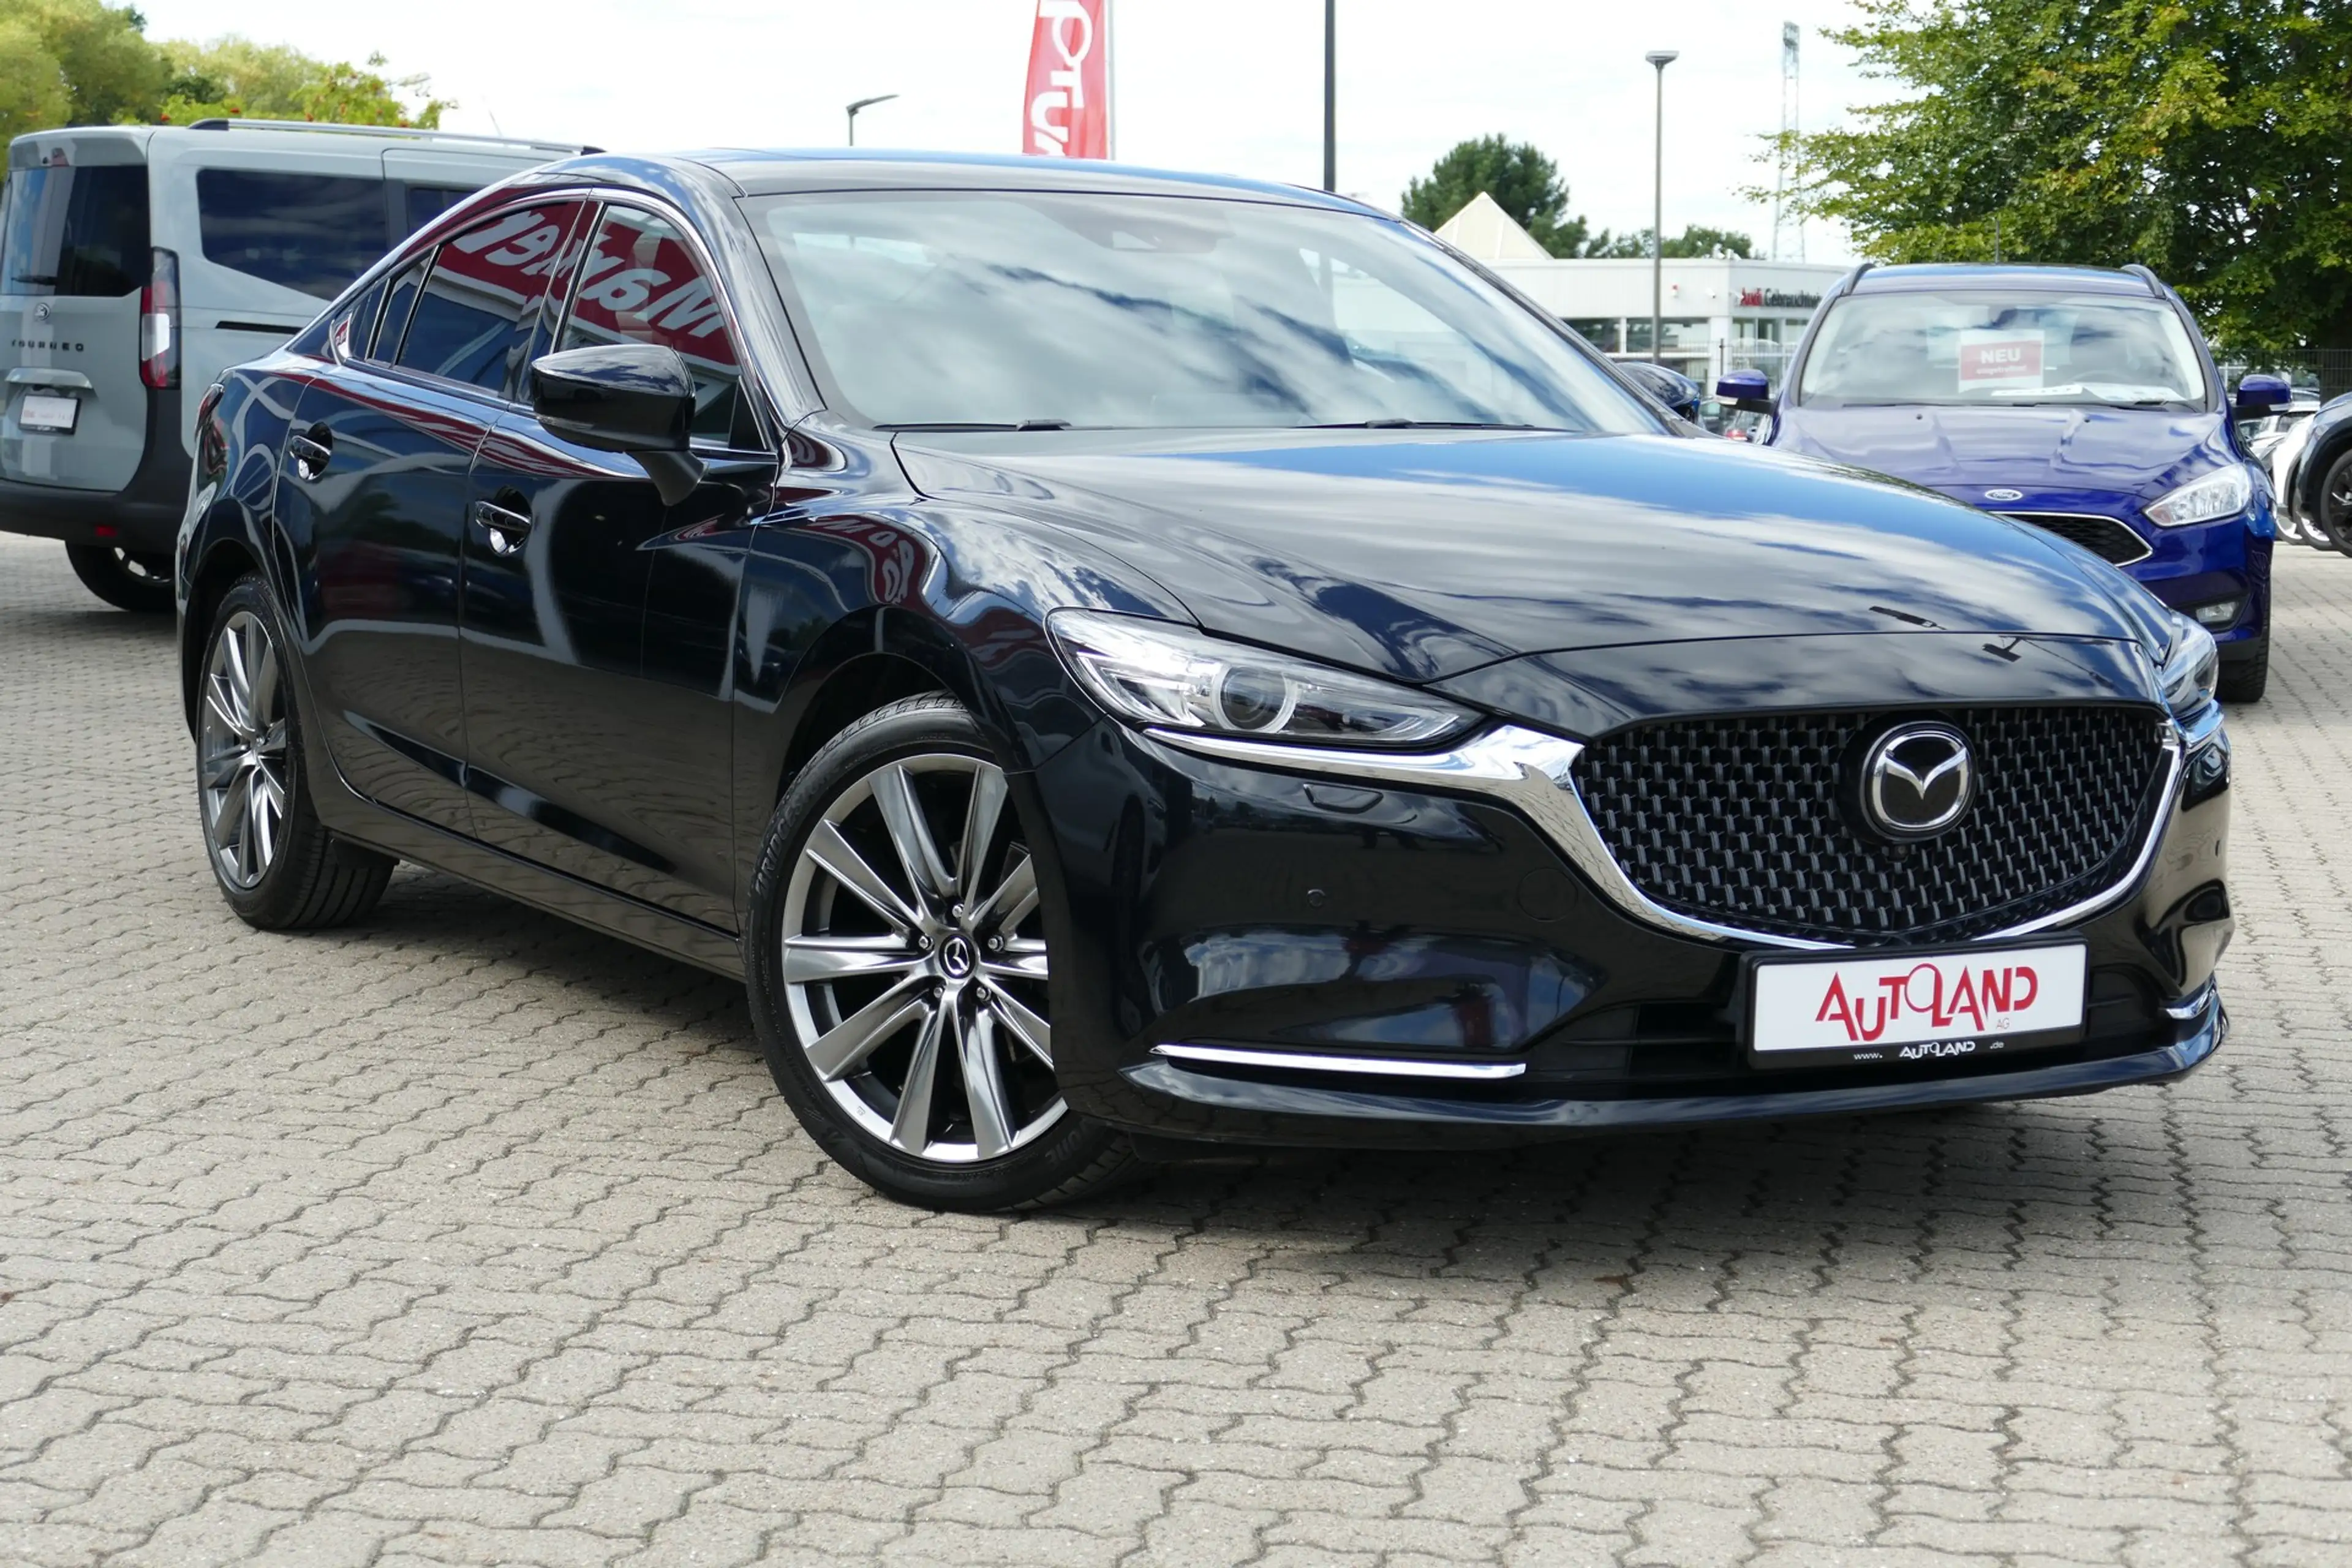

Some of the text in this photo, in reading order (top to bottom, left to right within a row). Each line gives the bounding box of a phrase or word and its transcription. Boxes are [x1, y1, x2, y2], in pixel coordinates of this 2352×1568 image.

[12, 339, 85, 352] TOURNEO
[1981, 347, 2021, 364] NEU
[1815, 962, 2038, 1042] AUTOLAND
[1996, 1017, 2011, 1030] AG
[1853, 1051, 1883, 1060] www.
[1899, 1041, 1977, 1060] AUTOLAND
